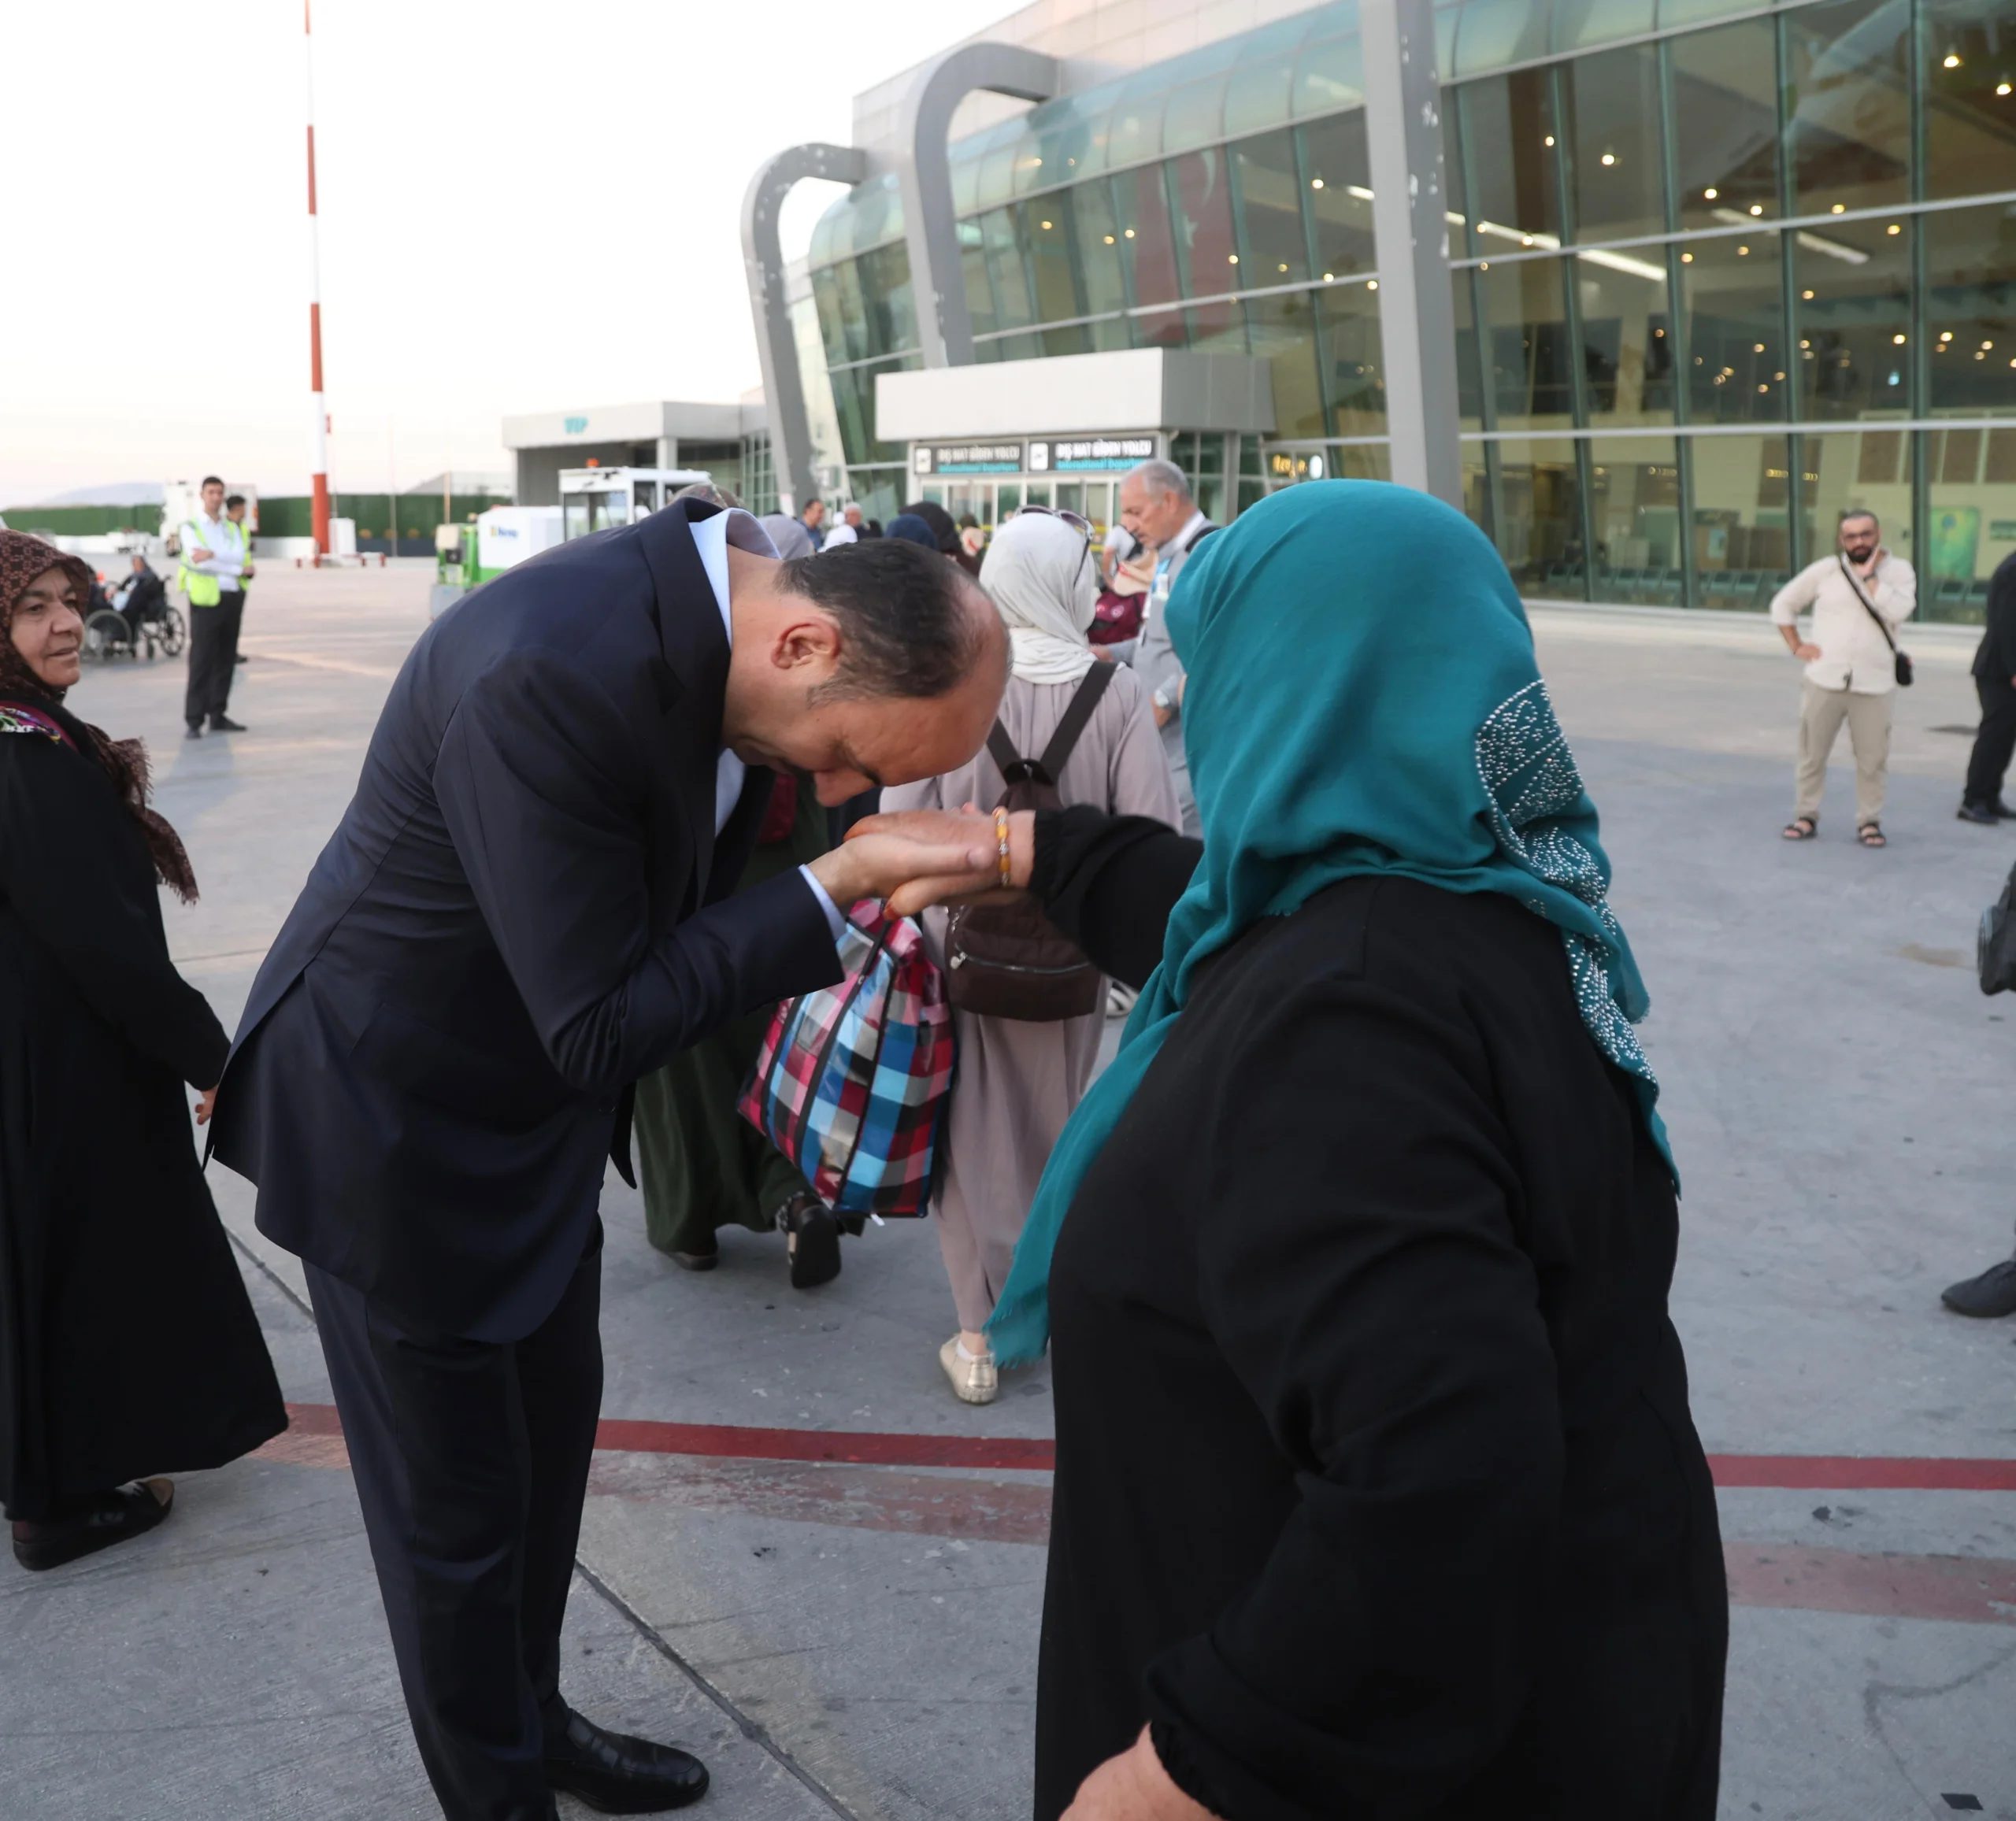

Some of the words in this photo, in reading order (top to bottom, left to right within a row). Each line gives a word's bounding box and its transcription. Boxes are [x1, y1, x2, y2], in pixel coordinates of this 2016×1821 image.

[564, 416, 588, 434] VIP
[1055, 442, 1073, 461] DIŞ
[1073, 442, 1091, 457] HAT
[1121, 440, 1151, 456] YOLCU
